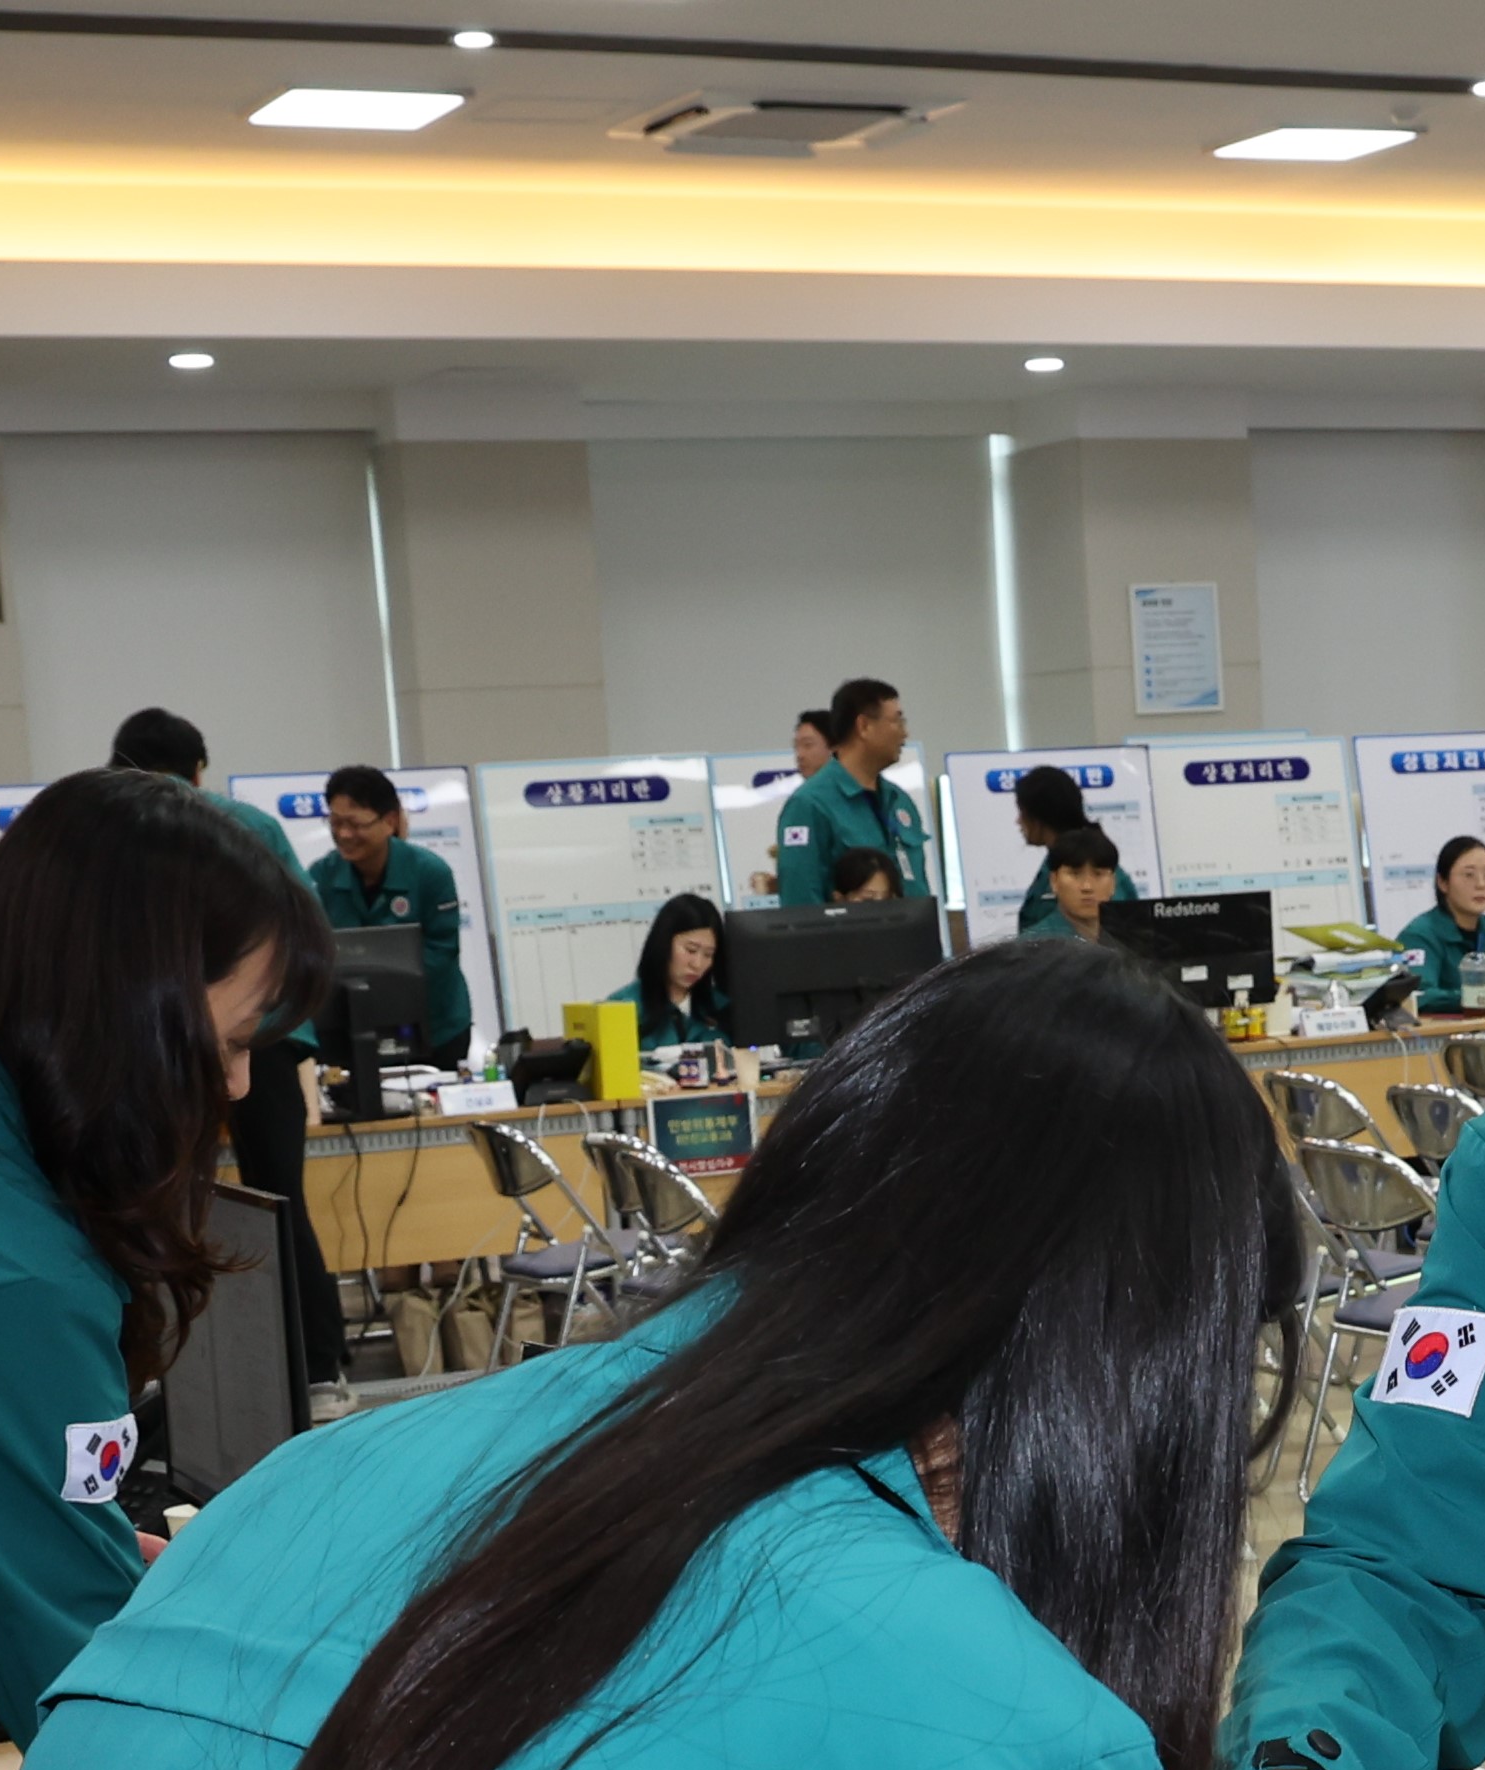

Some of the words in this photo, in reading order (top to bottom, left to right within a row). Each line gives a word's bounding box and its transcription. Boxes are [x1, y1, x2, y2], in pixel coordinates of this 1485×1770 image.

[1202, 760, 1293, 783] 상황처리반
[545, 779, 650, 805] 상황처리반
[1154, 901, 1220, 918] Redstone
